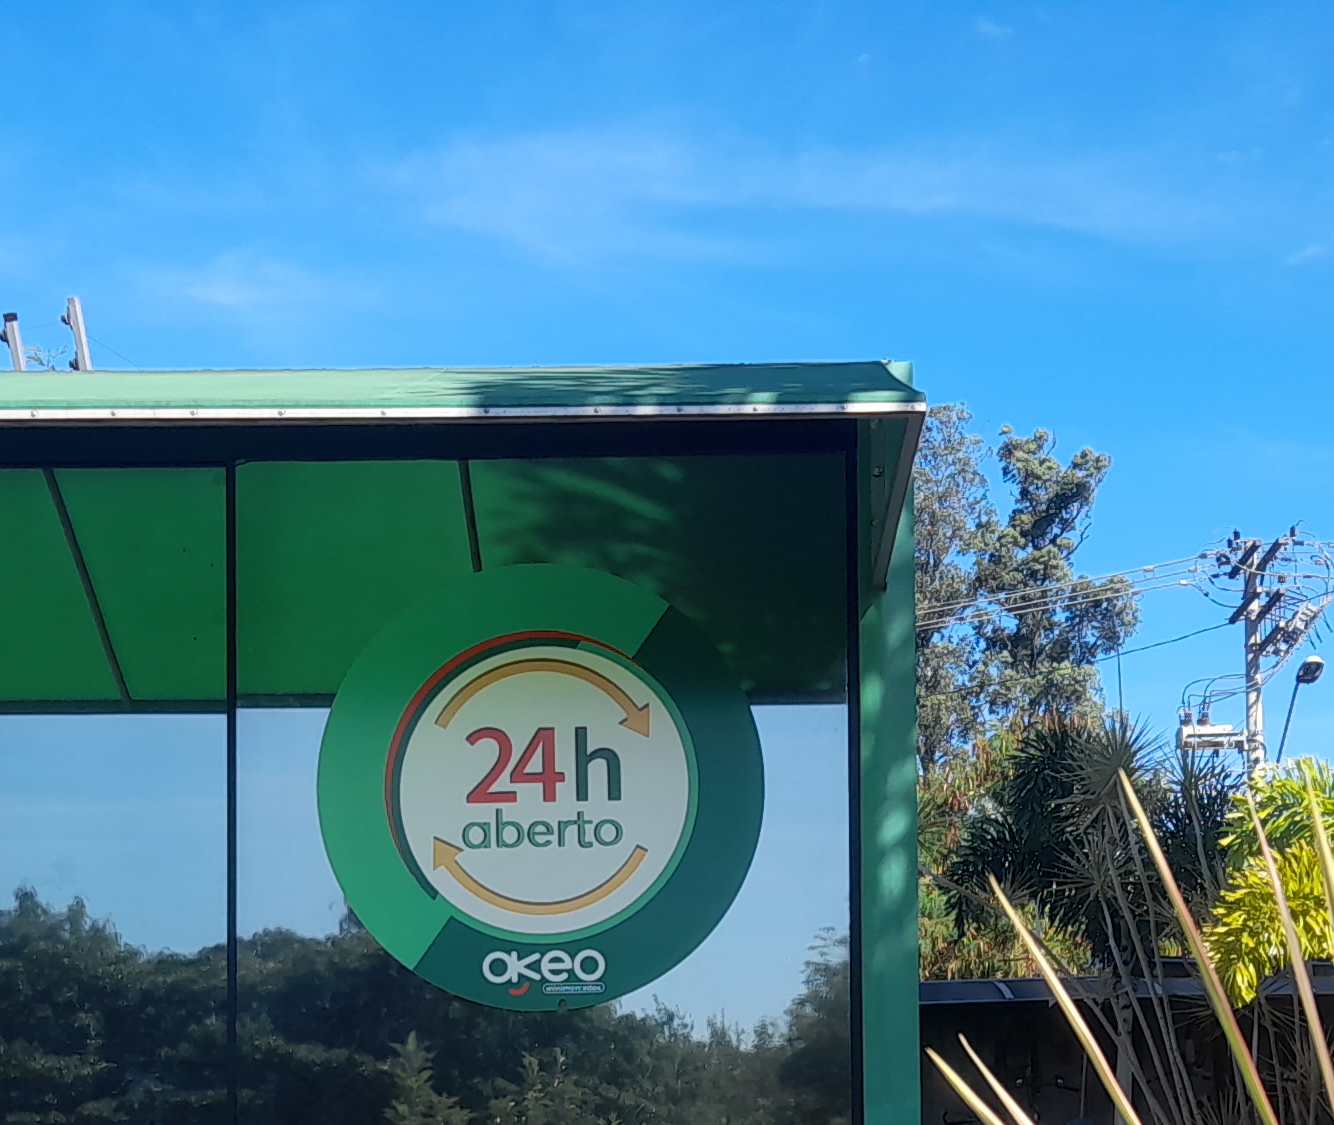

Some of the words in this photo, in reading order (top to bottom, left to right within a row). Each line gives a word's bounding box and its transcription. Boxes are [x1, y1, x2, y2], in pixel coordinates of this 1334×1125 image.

[465, 726, 622, 804] 24h
[461, 808, 624, 849] aberto
[482, 949, 606, 984] akeo
